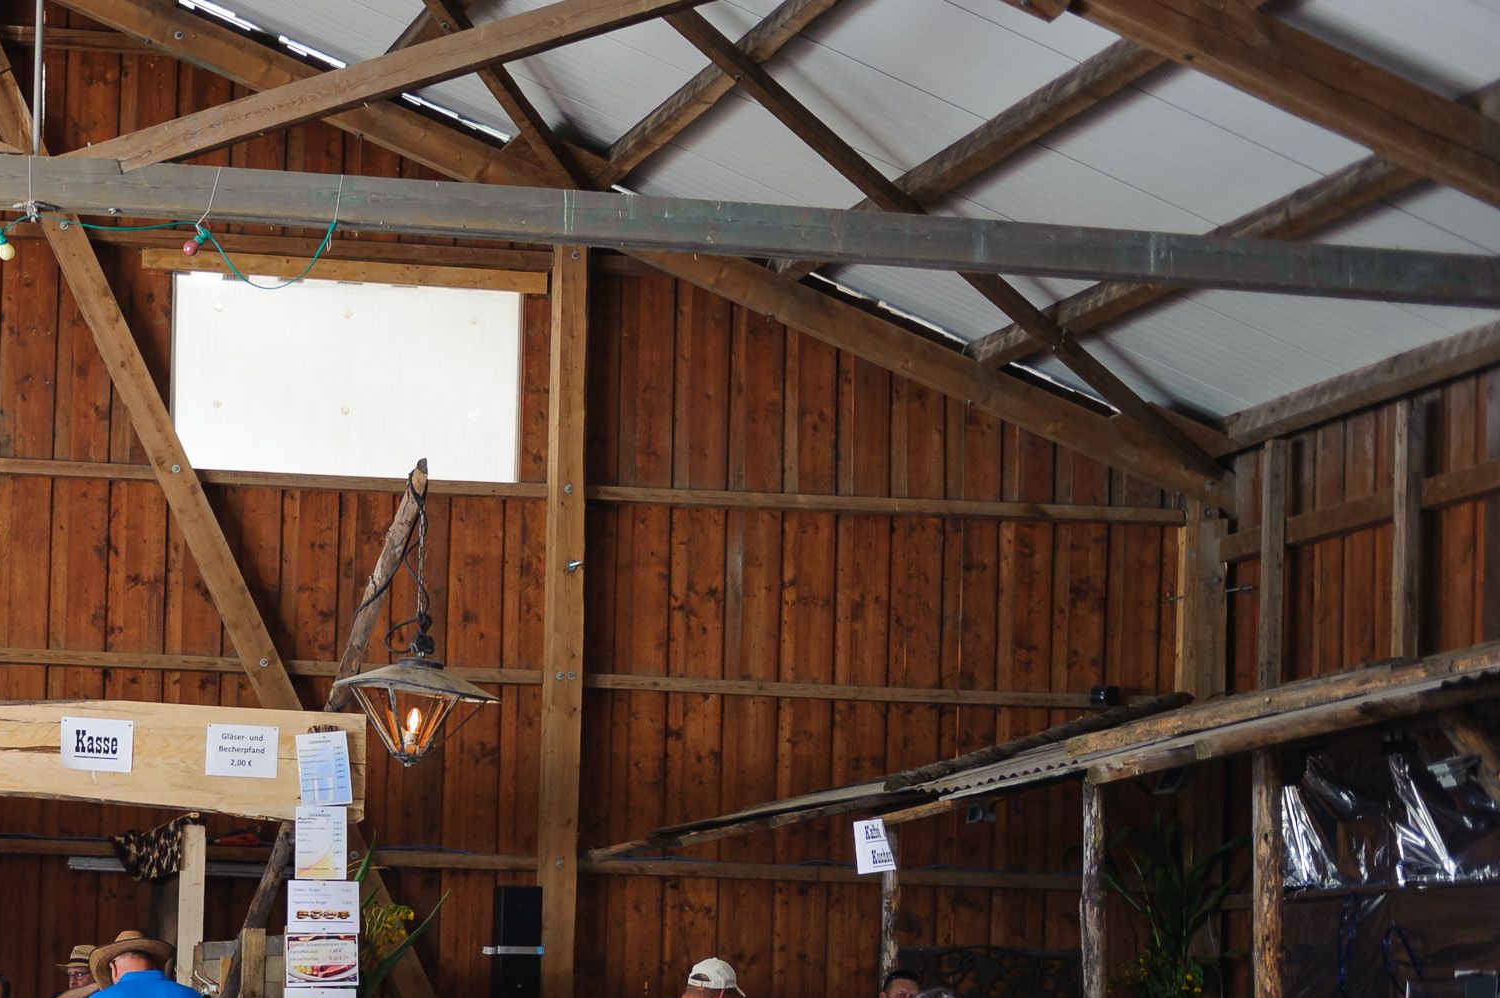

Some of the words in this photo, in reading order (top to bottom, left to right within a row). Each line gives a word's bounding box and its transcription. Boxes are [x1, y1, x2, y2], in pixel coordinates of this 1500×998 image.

[75, 729, 119, 755] Kasse
[221, 732, 248, 742] Gläser-
[249, 733, 264, 742] und
[218, 745, 266, 756] Becherpfand
[230, 759, 247, 768] 2,00
